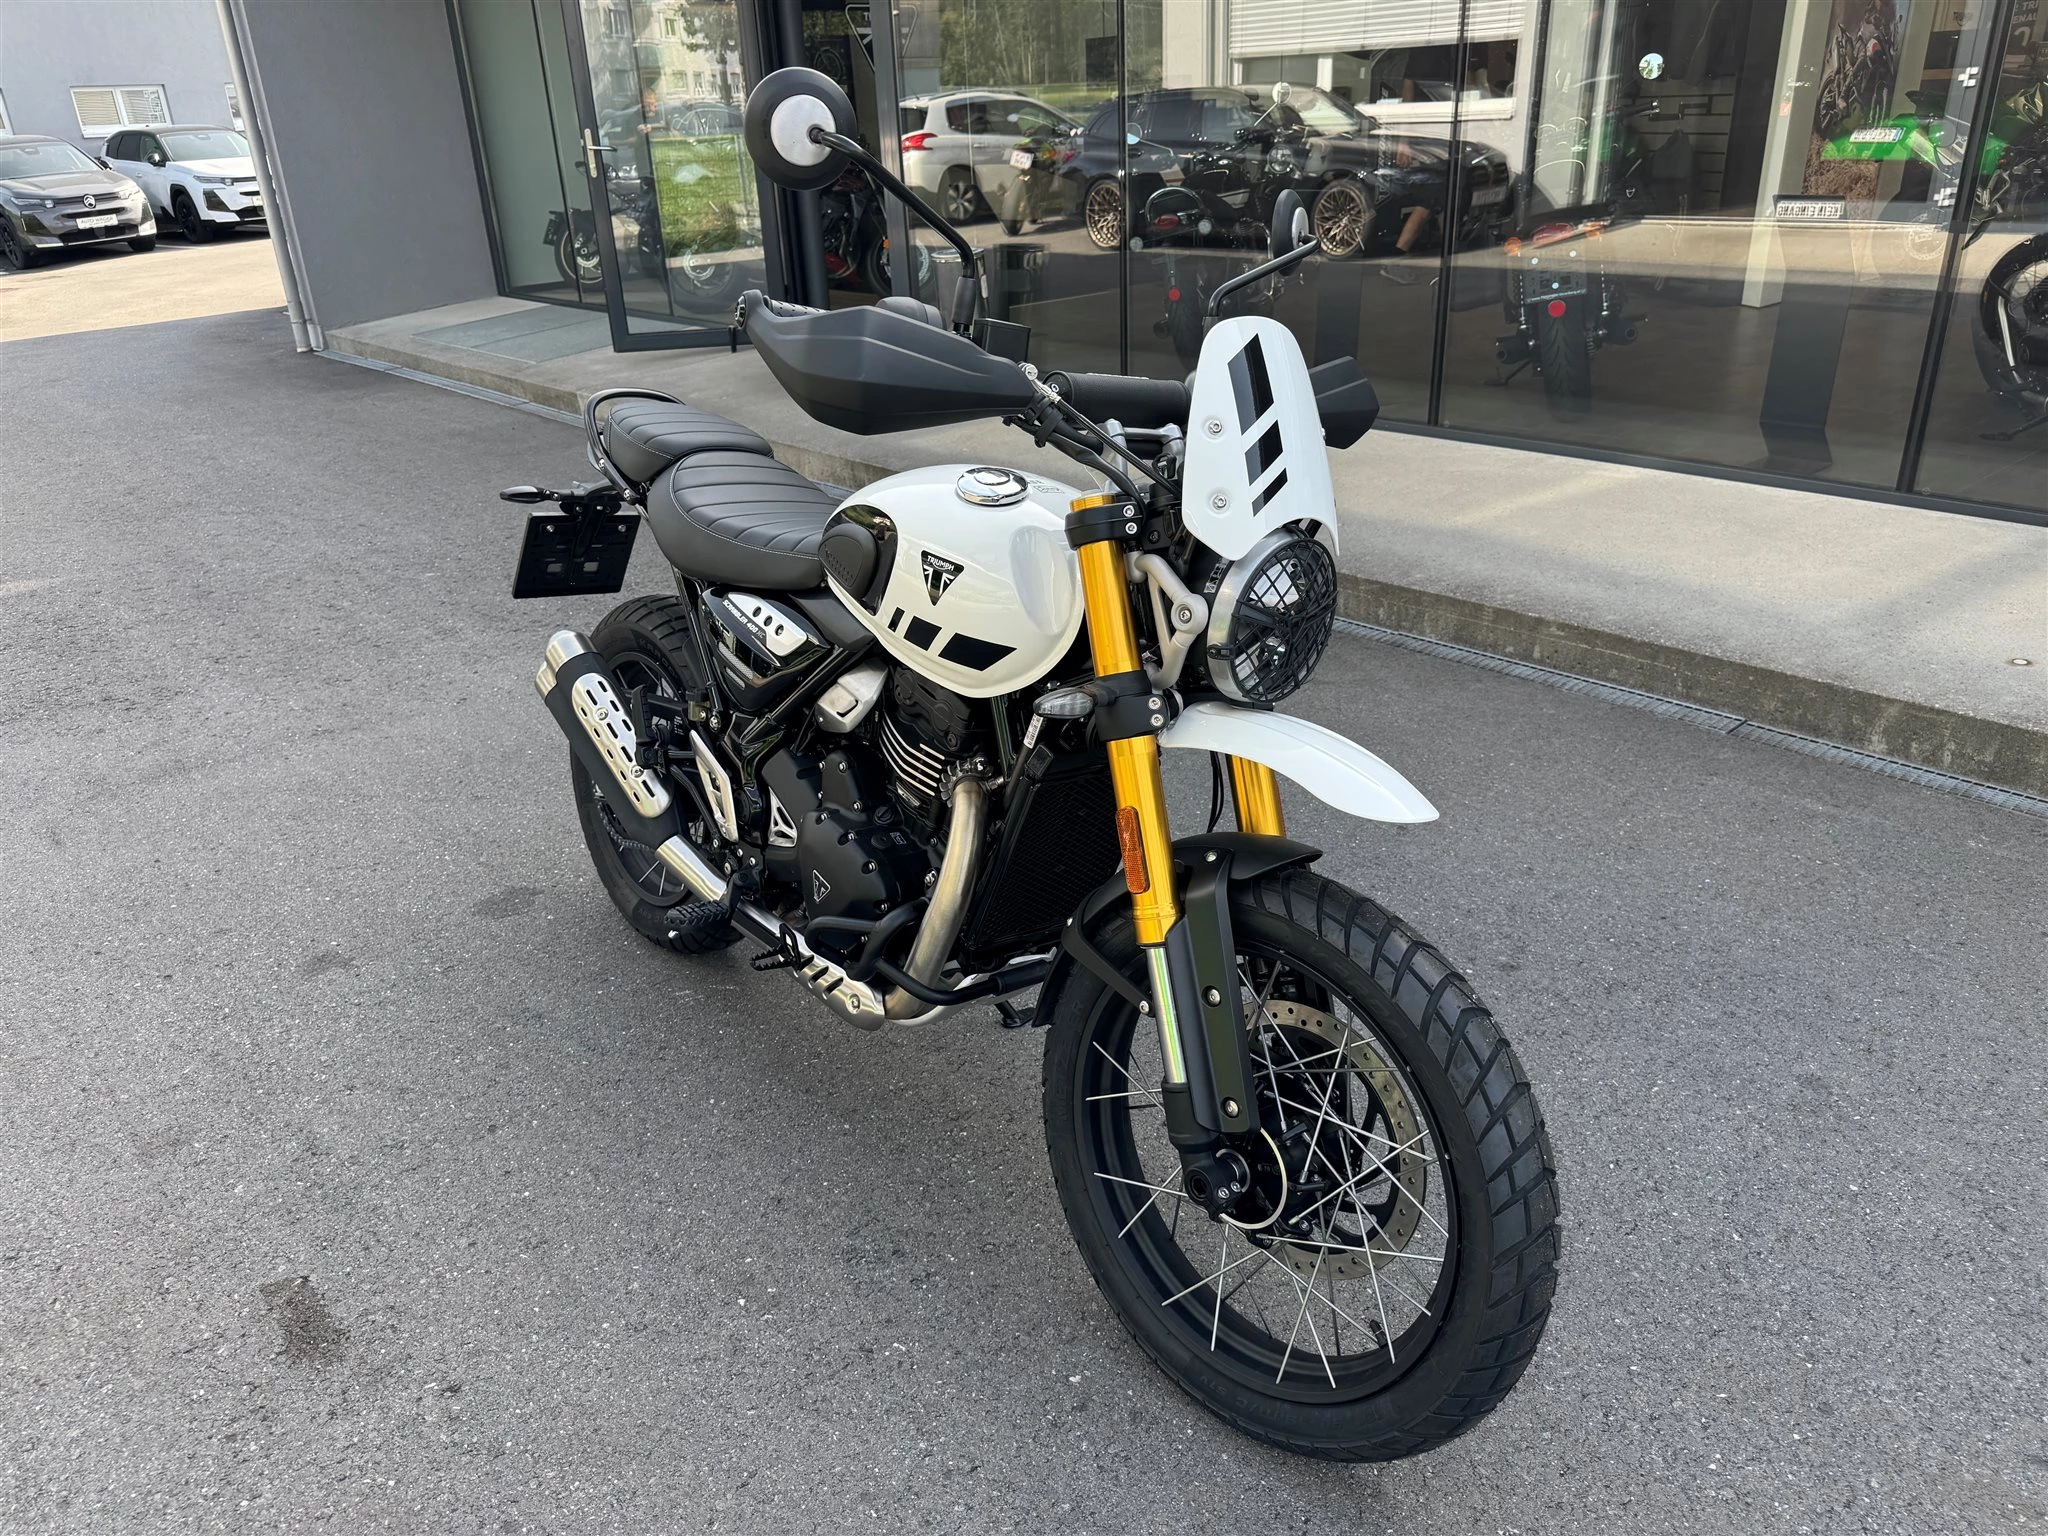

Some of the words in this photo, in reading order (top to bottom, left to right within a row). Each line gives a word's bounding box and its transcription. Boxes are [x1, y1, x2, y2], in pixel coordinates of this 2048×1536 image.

[927, 555, 954, 571] TRIUMPH
[722, 599, 748, 625] SCRAMBLER
[746, 622, 759, 633] 400
[757, 630, 766, 639] XC
